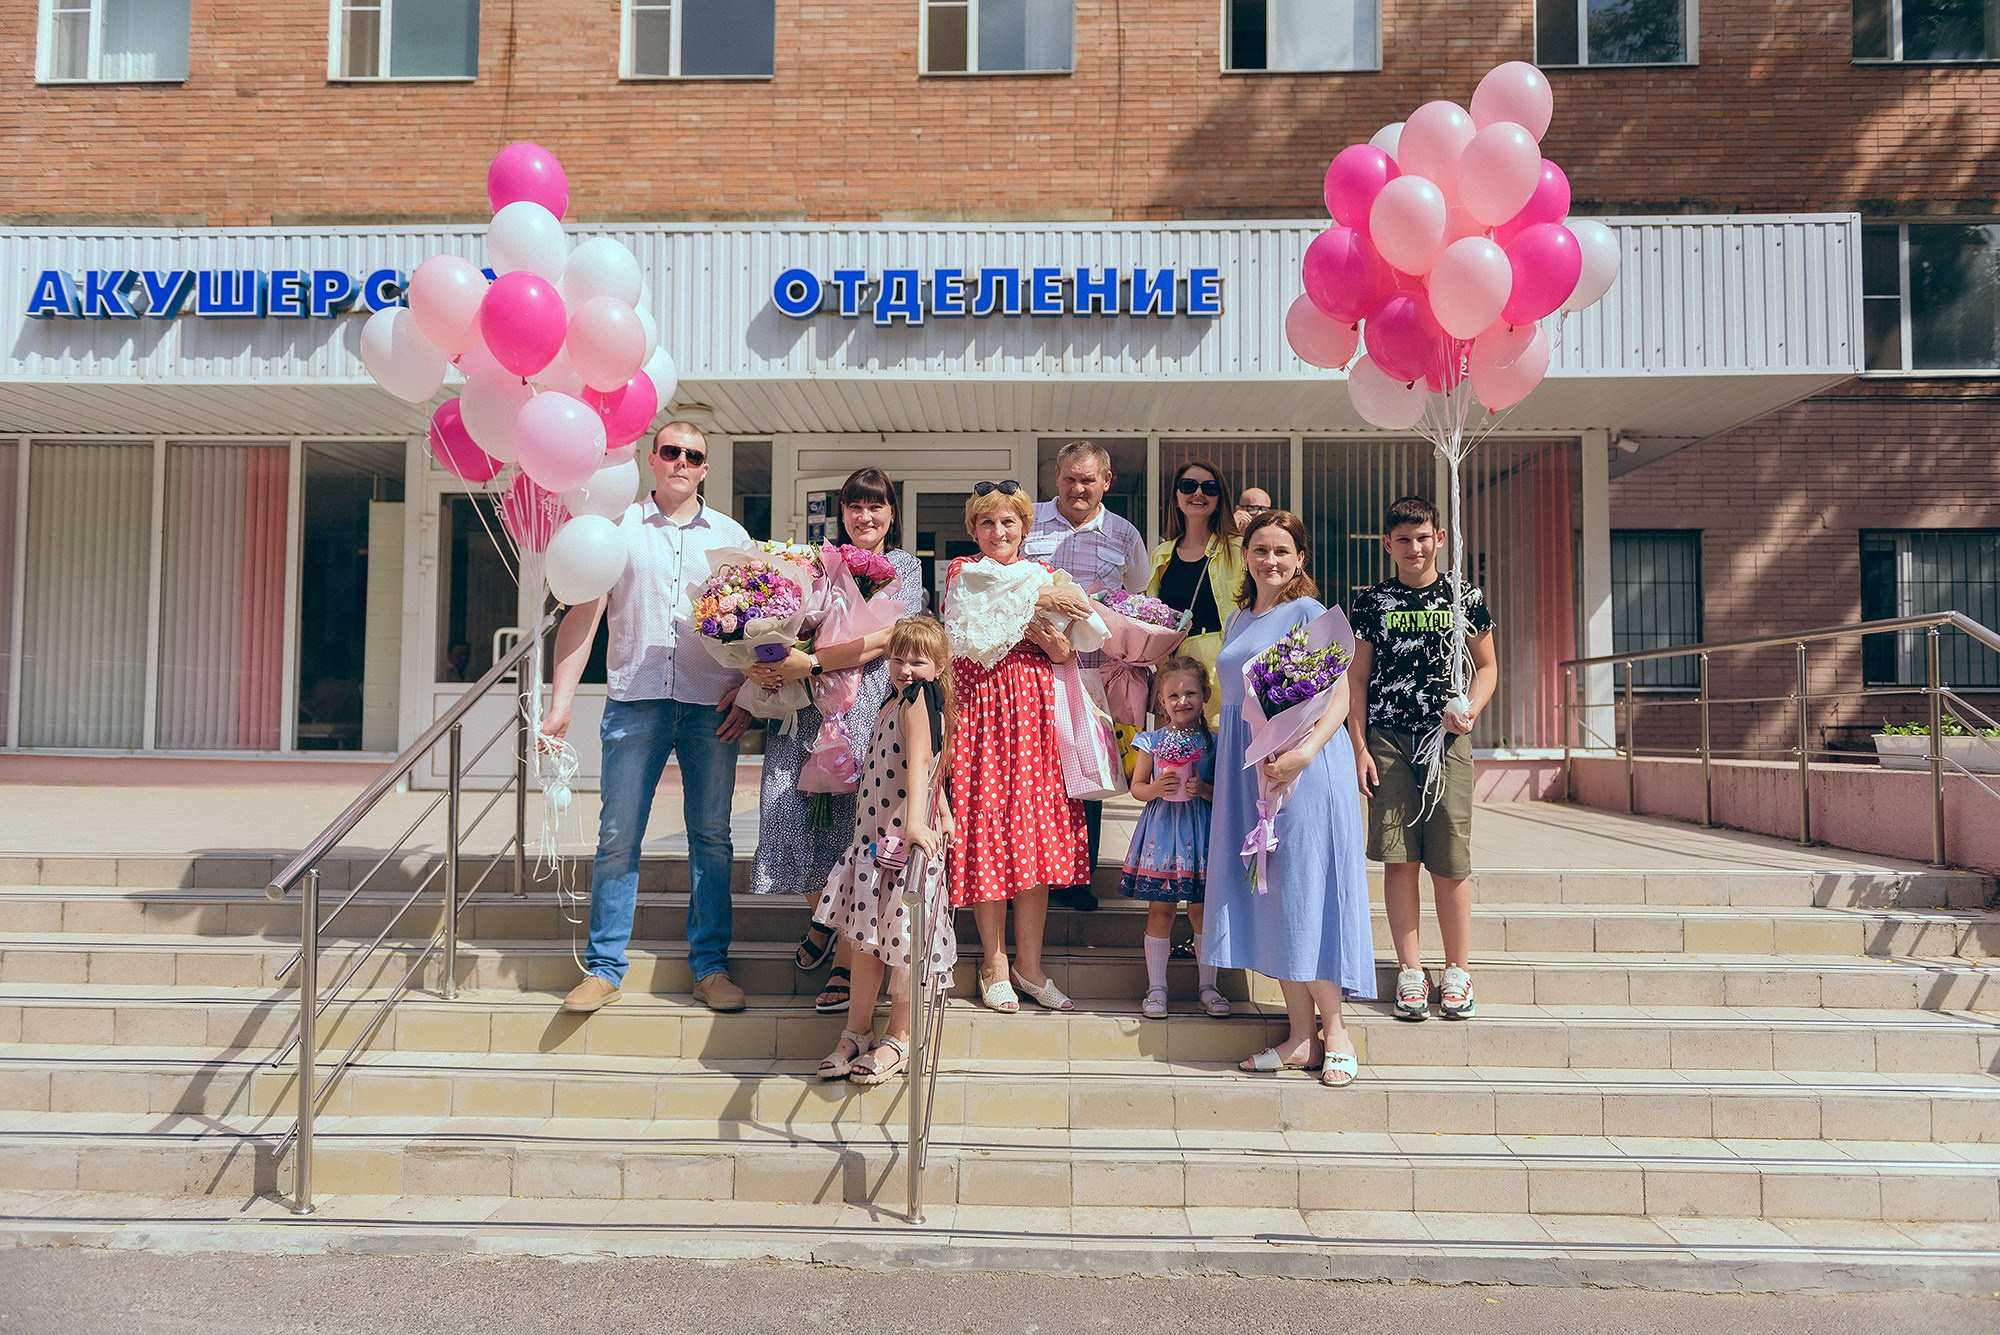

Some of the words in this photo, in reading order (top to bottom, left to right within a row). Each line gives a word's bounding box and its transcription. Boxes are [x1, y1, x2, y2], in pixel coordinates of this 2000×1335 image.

[24, 268, 497, 318] АКУШЕРС
[771, 266, 1221, 326] ОТДЕЛЕНИЕ
[1390, 612, 1418, 628] CAN
[1423, 612, 1451, 628] YOU
